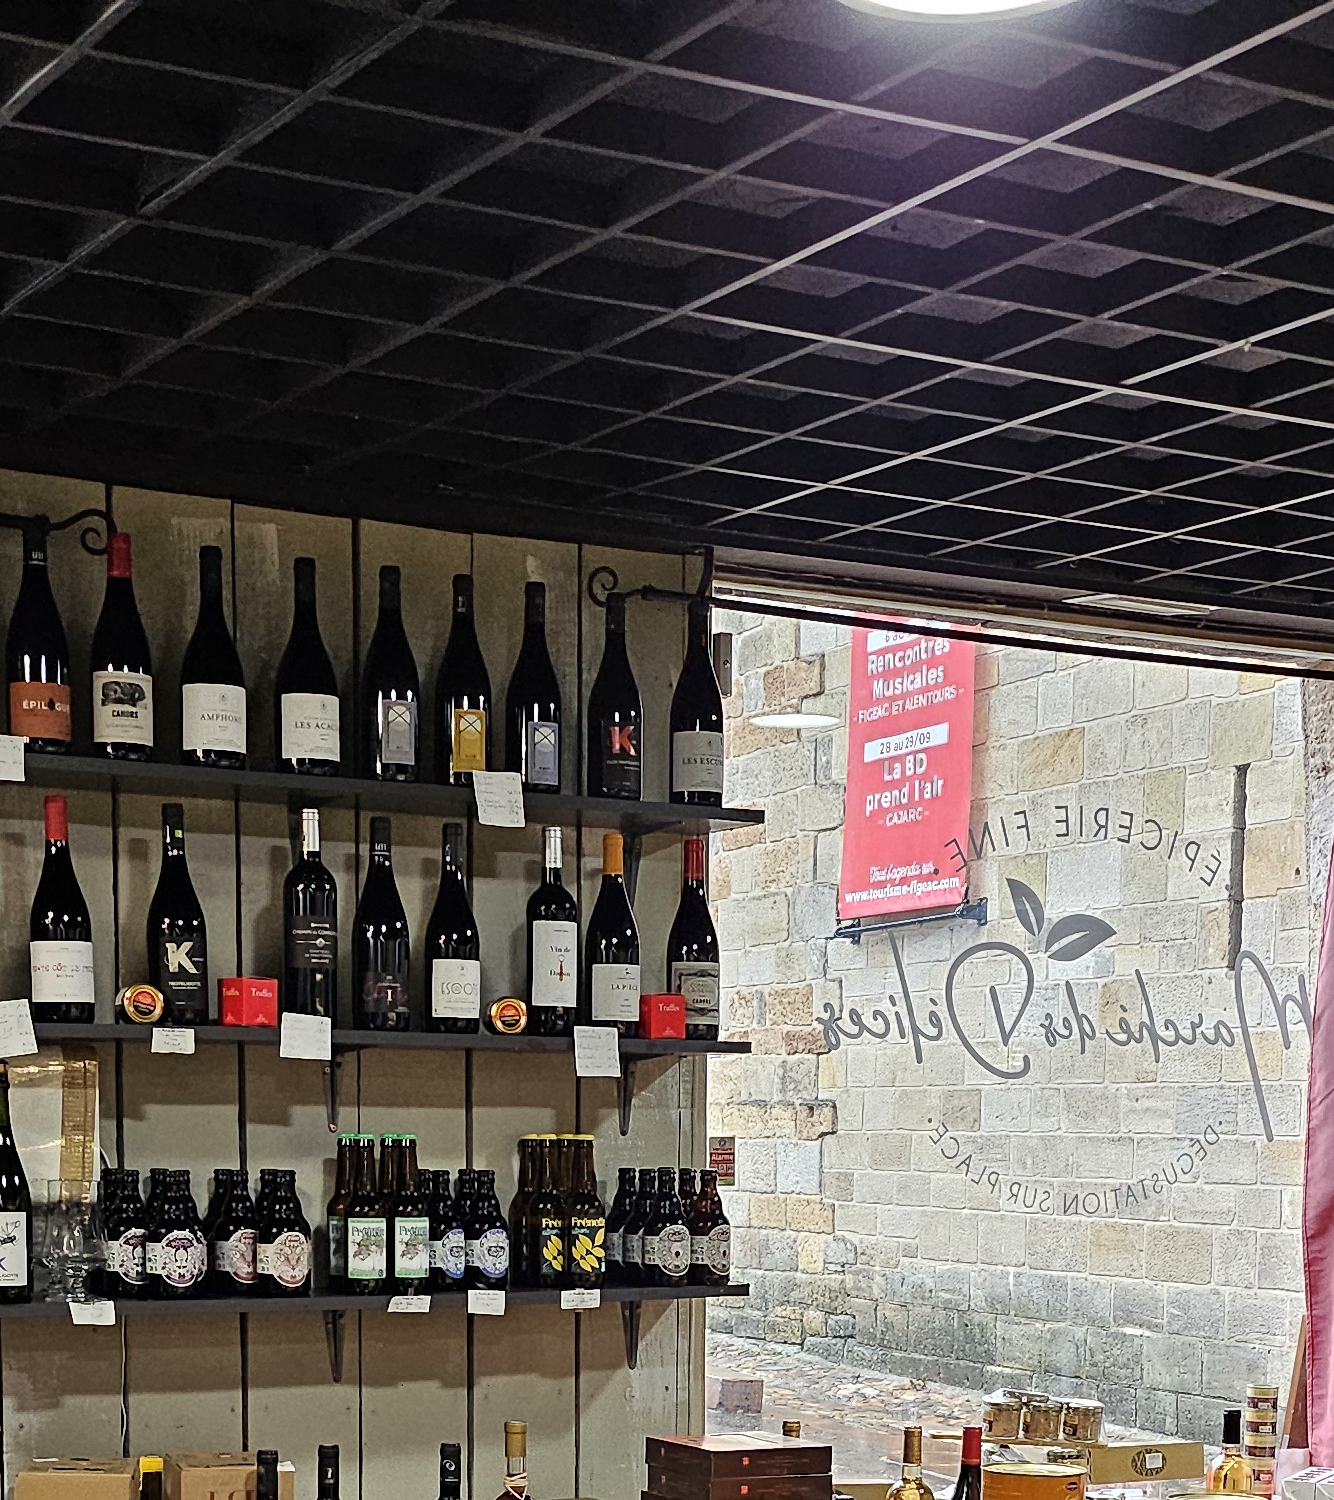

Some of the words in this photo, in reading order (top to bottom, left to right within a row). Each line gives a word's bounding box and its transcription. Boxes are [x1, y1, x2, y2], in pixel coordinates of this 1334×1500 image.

[868, 638, 950, 676] Rencontres
[872, 664, 945, 701] Musicales
[858, 702, 890, 724] FIGEAC
[891, 698, 905, 715] ET
[904, 684, 957, 712] ALENTOURS
[608, 725, 638, 757] K
[879, 741, 891, 754] 28
[893, 740, 904, 752] au
[883, 760, 902, 782] La
[905, 752, 928, 777] BD
[865, 782, 910, 817] prend
[914, 774, 945, 802] l'air
[885, 806, 923, 827] CAJARC
[845, 876, 961, 906] www.tourisme-figeac.com
[165, 941, 200, 974] K
